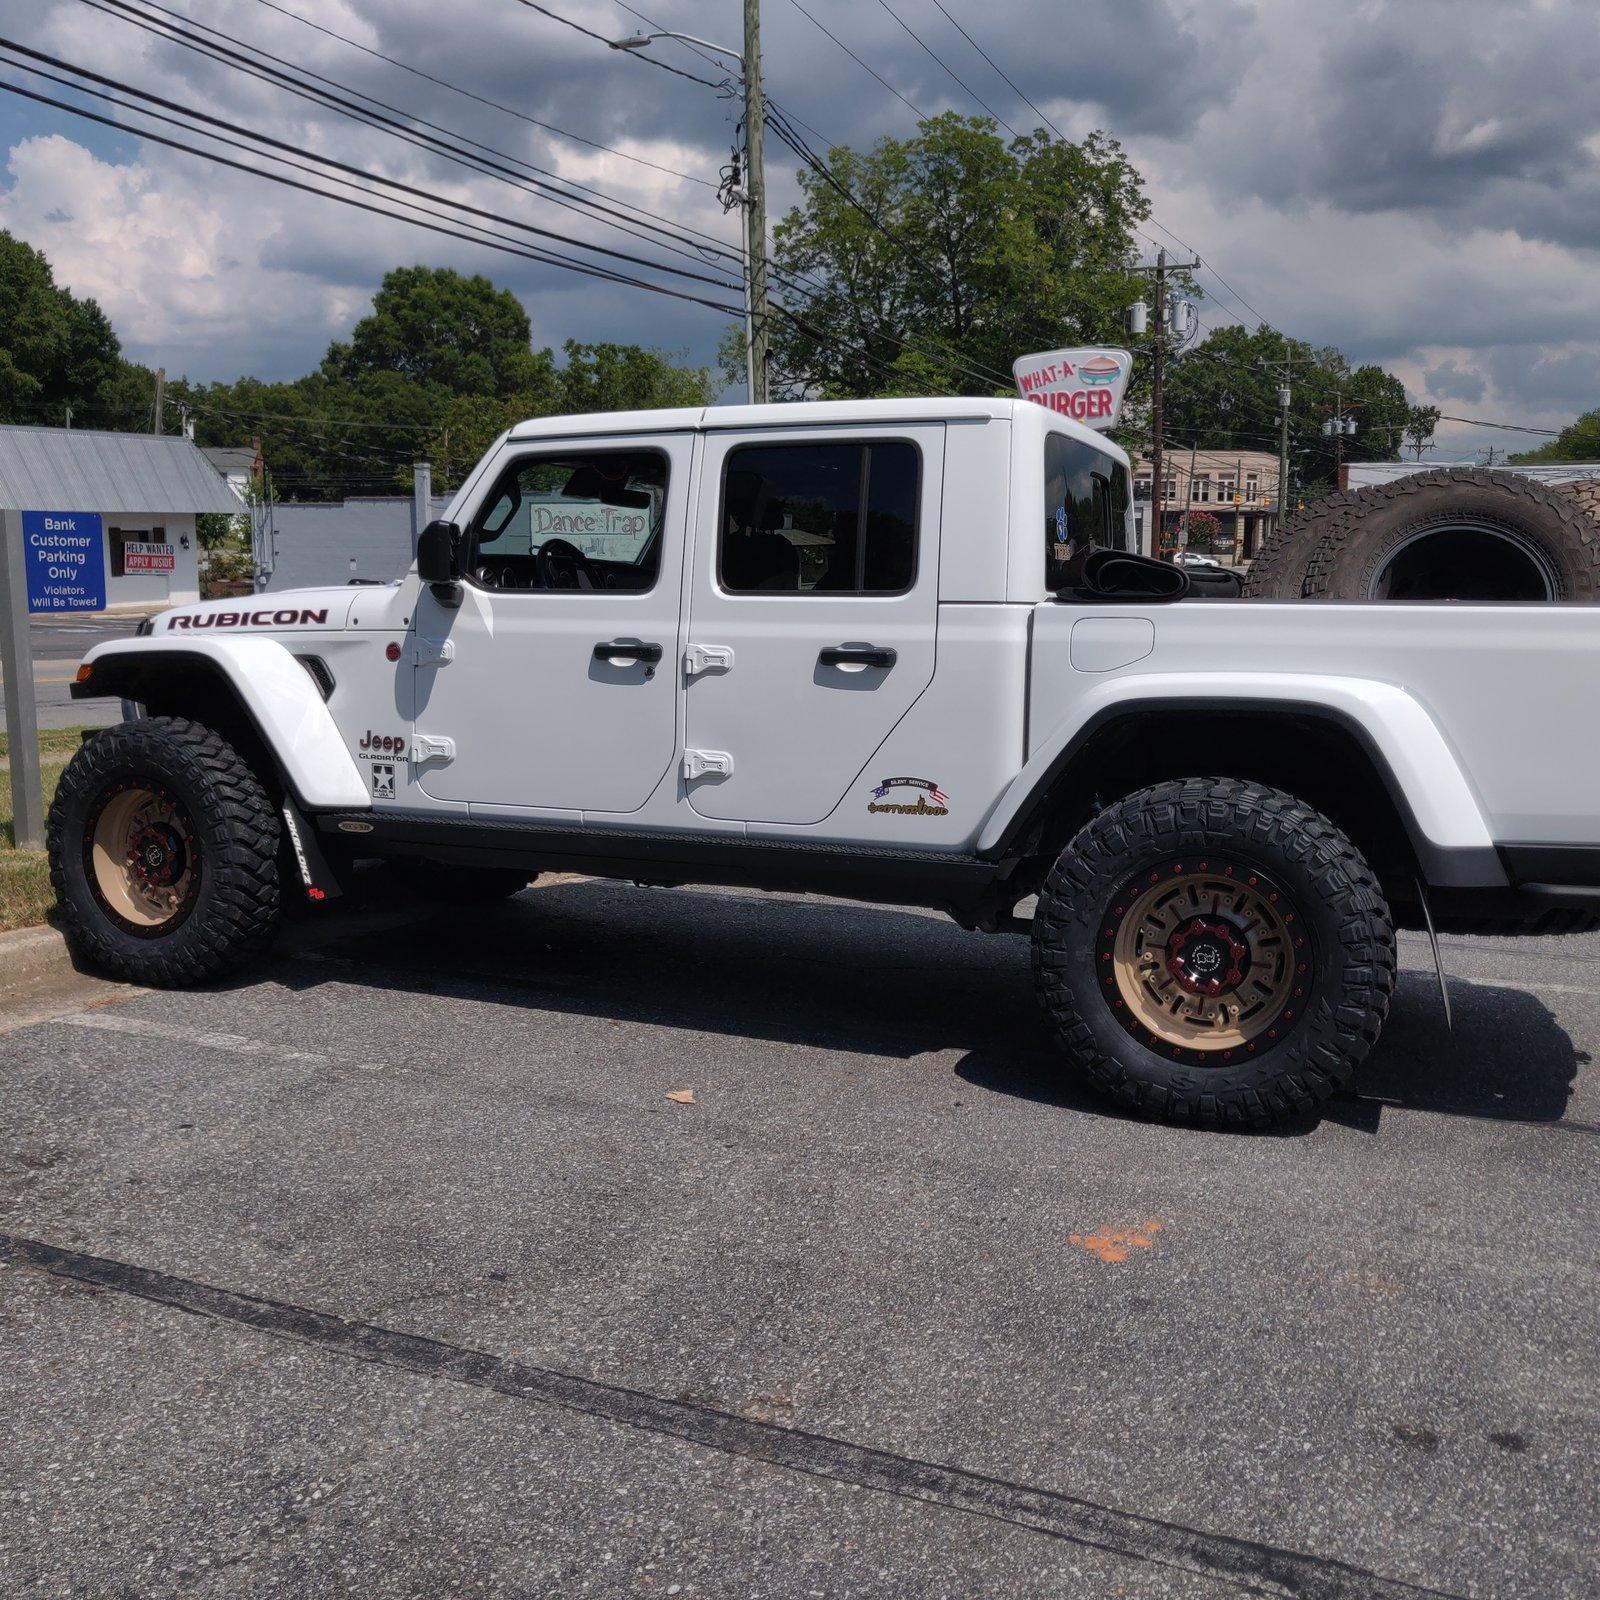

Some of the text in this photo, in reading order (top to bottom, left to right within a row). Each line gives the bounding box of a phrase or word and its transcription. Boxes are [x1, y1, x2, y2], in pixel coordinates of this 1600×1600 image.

[44, 518, 76, 531] Bank
[600, 506, 646, 541] Trap
[30, 534, 91, 547] Customer
[126, 543, 175, 555] HELP WANTED
[38, 550, 86, 565] Parking
[128, 556, 173, 568] APPLY INSIDE
[48, 566, 77, 581] Only
[43, 586, 85, 595] Violators
[32, 597, 98, 607] Will Be Towed
[167, 609, 329, 631] RUBICON
[359, 729, 406, 756] Jeep
[358, 752, 409, 762] GLADIATOR
[908, 780, 930, 788] SERVICE
